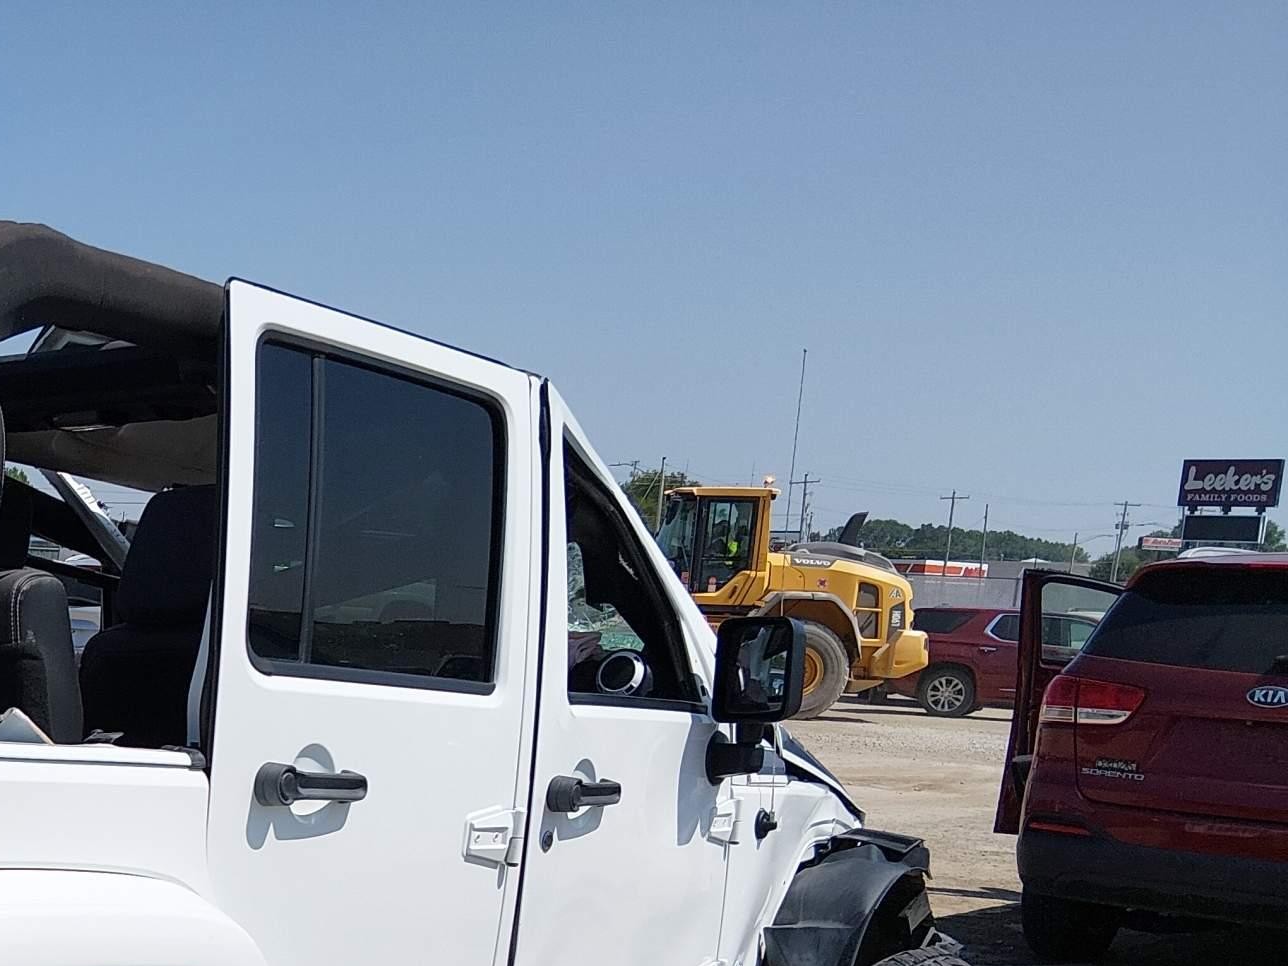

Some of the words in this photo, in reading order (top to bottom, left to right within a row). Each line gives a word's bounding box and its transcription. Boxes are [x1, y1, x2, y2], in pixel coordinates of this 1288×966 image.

[1184, 466, 1275, 491] Leeker's
[1187, 494, 1227, 502] FAMILY
[1231, 494, 1267, 502] FOODS
[794, 558, 831, 566] VOLVO
[1254, 690, 1286, 703] KIA
[1081, 767, 1145, 781] SORENTO
